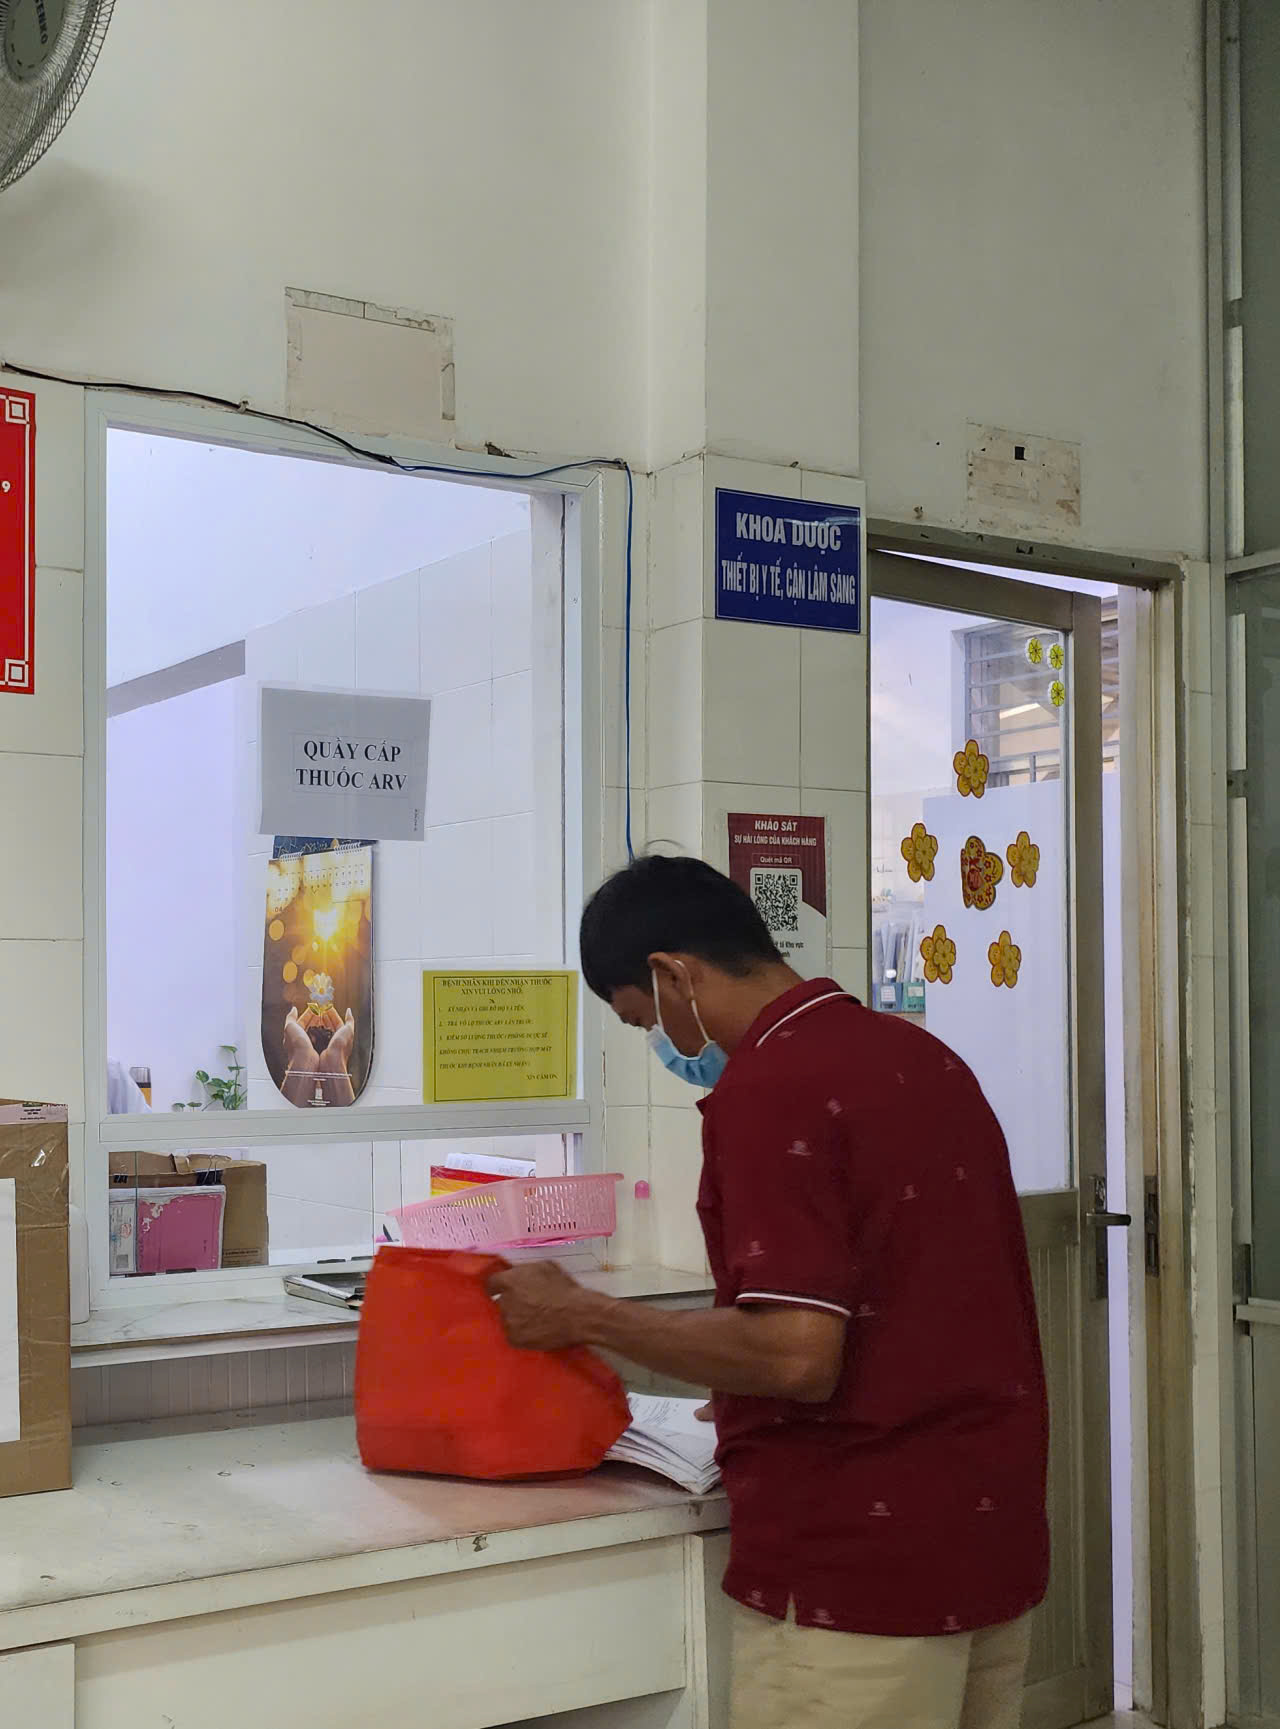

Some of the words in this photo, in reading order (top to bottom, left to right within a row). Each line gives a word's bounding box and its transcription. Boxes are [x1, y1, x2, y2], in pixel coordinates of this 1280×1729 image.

[736, 512, 786, 544] KHOA
[791, 519, 841, 555] DƯỢC
[722, 552, 747, 592] THIẾT
[749, 563, 759, 600] BỊ
[762, 565, 768, 595] Y
[770, 557, 784, 600] TẾ,
[786, 562, 805, 605] CẬN
[808, 564, 828, 602] LÂM
[303, 737, 359, 762] QUẦY
[364, 740, 401, 763] CẤP
[296, 766, 364, 789] THUỐC
[368, 774, 407, 791] ARV
[755, 818, 779, 831] KHẢO
[781, 820, 797, 832] SÁT
